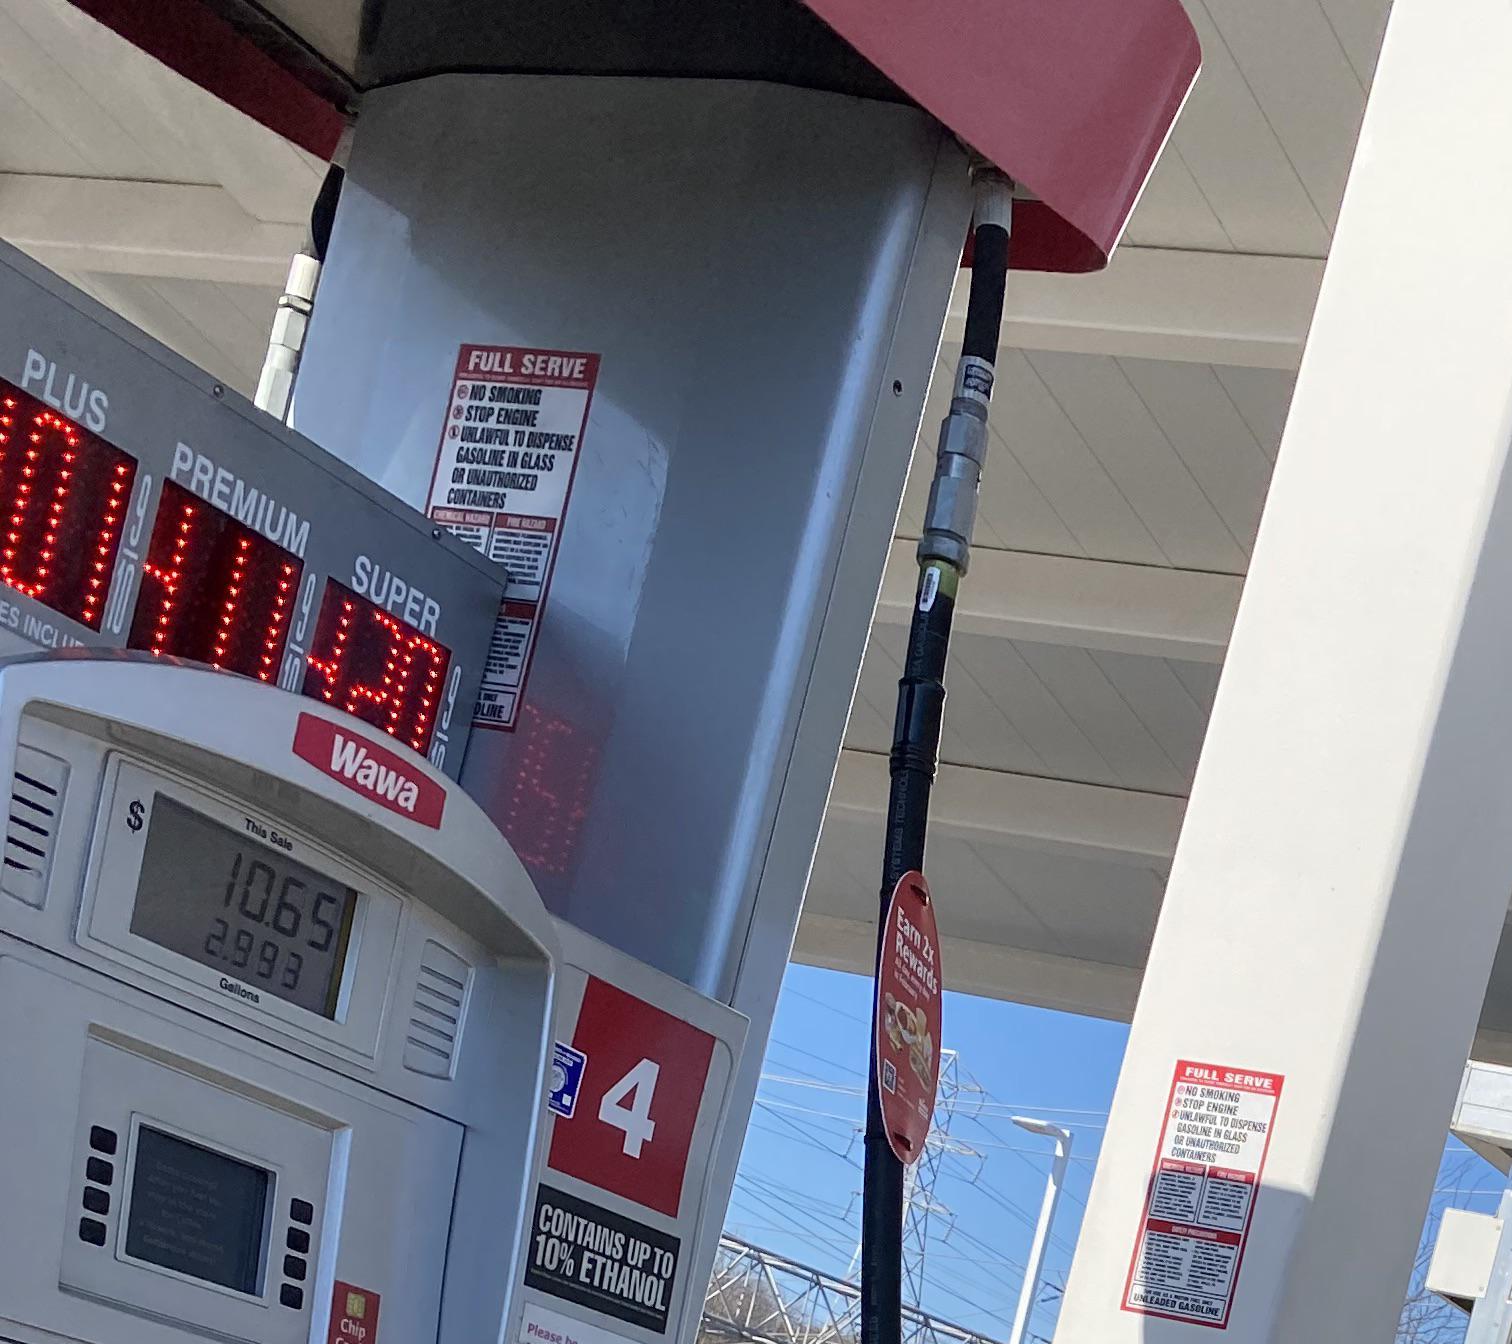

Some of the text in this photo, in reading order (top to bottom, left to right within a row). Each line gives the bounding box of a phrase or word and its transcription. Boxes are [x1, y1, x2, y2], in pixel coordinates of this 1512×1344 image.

[468, 350, 587, 379] FULL SERVE
[21, 349, 109, 432] PLUS
[469, 384, 542, 406] NO SMOKING
[465, 405, 539, 427] STOP ENGINE
[460, 425, 576, 452] UNLAWFUL TO DISPENSE
[456, 446, 555, 472] GASOLINE IN GLASS
[451, 467, 538, 491] OR UNAUTHORIZED
[169, 441, 311, 558] PREMIUM
[447, 488, 507, 509] CONTAINERS
[351, 555, 441, 636] SUPER
[330, 733, 419, 813] Wawa
[126, 800, 145, 834] $
[245, 818, 293, 851] This Sale
[897, 905, 921, 950] Earn
[896, 930, 937, 995] Rewards
[219, 977, 260, 1004] Gallons
[1185, 1066, 1219, 1081] FULL
[1224, 1073, 1273, 1089] SERVE
[1182, 1098, 1239, 1116] STOP ENGINE
[1186, 1086, 1240, 1103] NO SMOKING
[598, 1058, 660, 1160] 4
[1179, 1110, 1267, 1133] UNLAWFUL TO DISPENSE
[1174, 1135, 1240, 1154] OR UNAUTHORIZED
[1177, 1122, 1248, 1143] GASOLINE IN GLASS
[1171, 1147, 1217, 1163] CONTAINERS
[538, 1203, 674, 1279] CONTAINS UP TO
[535, 1234, 575, 1277] 10%
[579, 1250, 666, 1311] ETHANOL
[1178, 1301, 1220, 1317] GASOLINE
[340, 1318, 366, 1341] Chip
